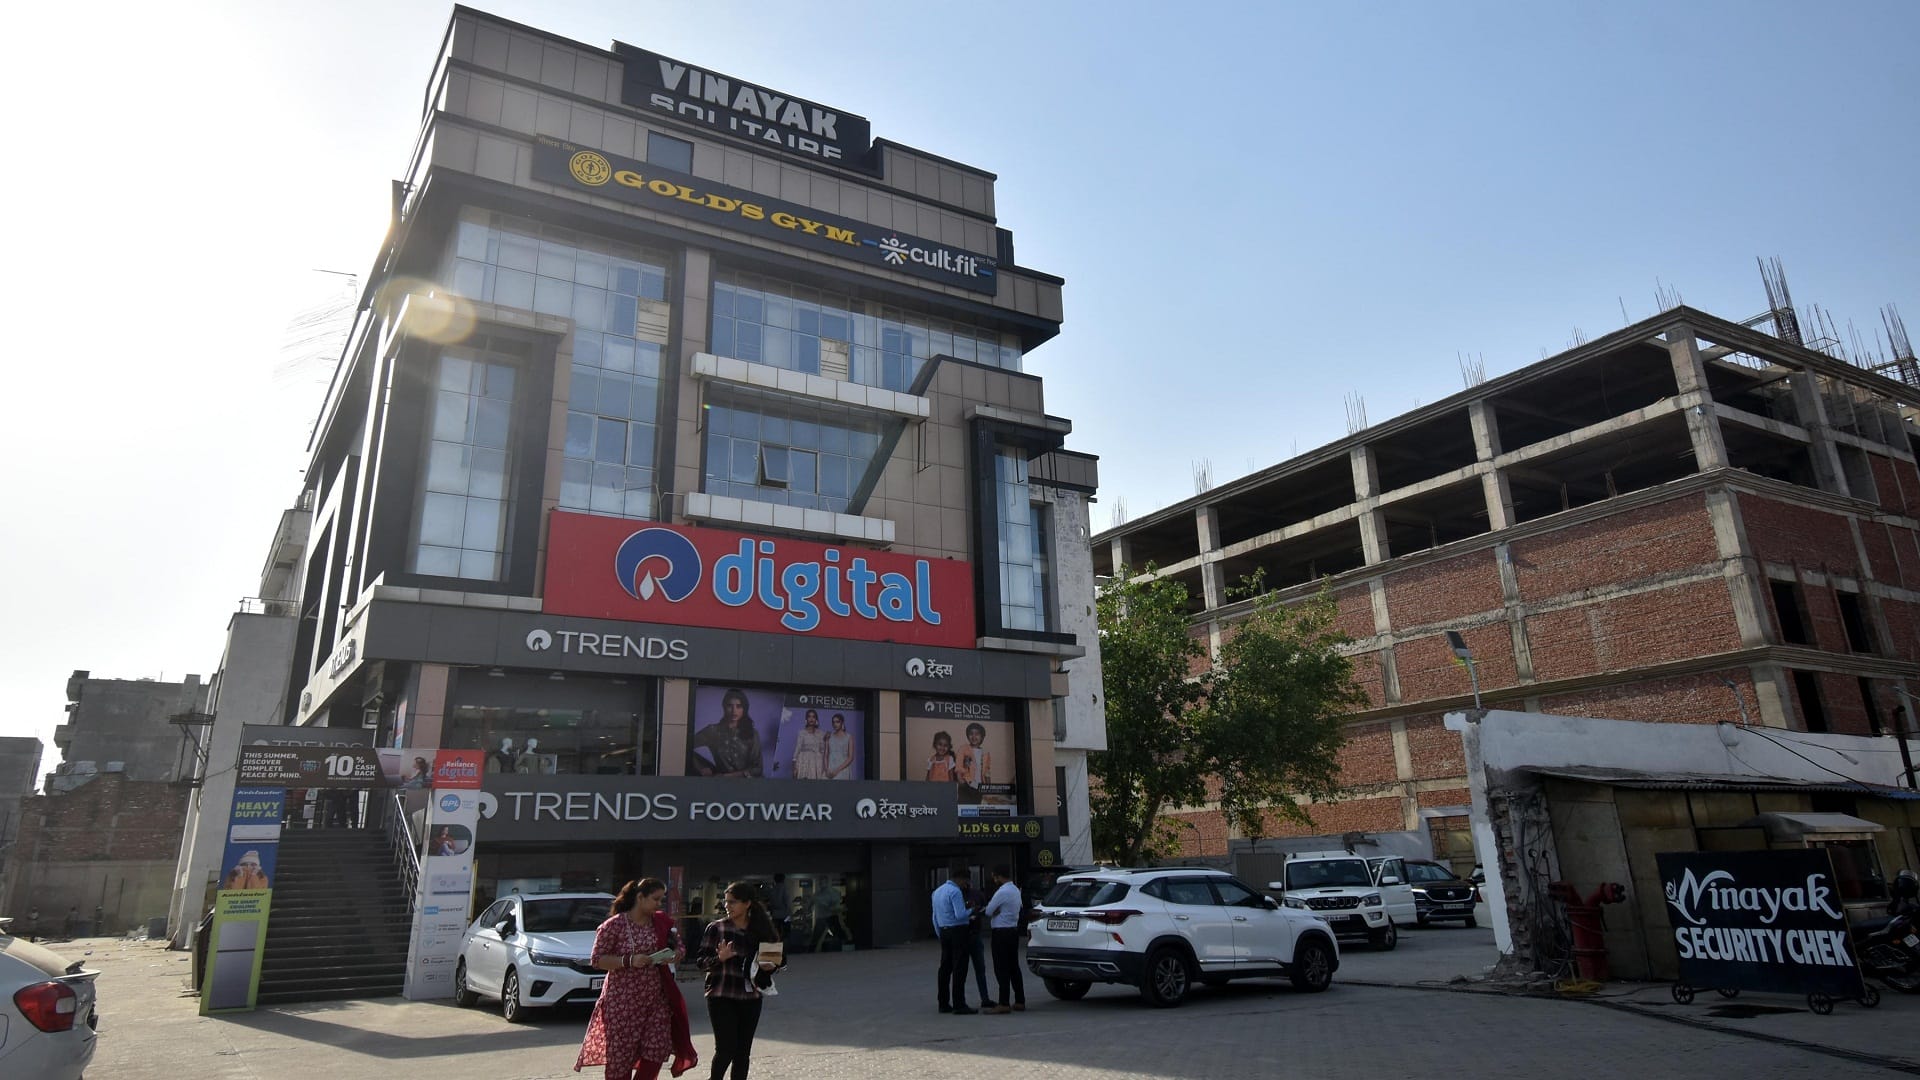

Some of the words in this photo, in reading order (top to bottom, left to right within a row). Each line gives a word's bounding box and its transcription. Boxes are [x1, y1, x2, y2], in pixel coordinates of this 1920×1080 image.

[658, 60, 837, 140] VINAYAK
[614, 168, 765, 221] GOLD'S
[910, 246, 978, 278] cult.fit
[713, 538, 941, 632] digital
[556, 630, 689, 661] TRENDS
[808, 695, 855, 706] TRENDS
[935, 701, 991, 715] TRENDS
[263, 752, 299, 760] SUMMER,
[324, 755, 354, 776] 10
[356, 756, 365, 764] %
[438, 763, 478, 779] digital
[236, 802, 280, 810] HEAVY
[505, 792, 677, 821] TRENDS
[690, 801, 832, 821] FOOTWEAR
[993, 823, 1020, 833] GYM
[1667, 867, 1843, 925] Vinayak
[1675, 926, 1786, 963] SECURITY
[1786, 929, 1854, 966] CHEK
